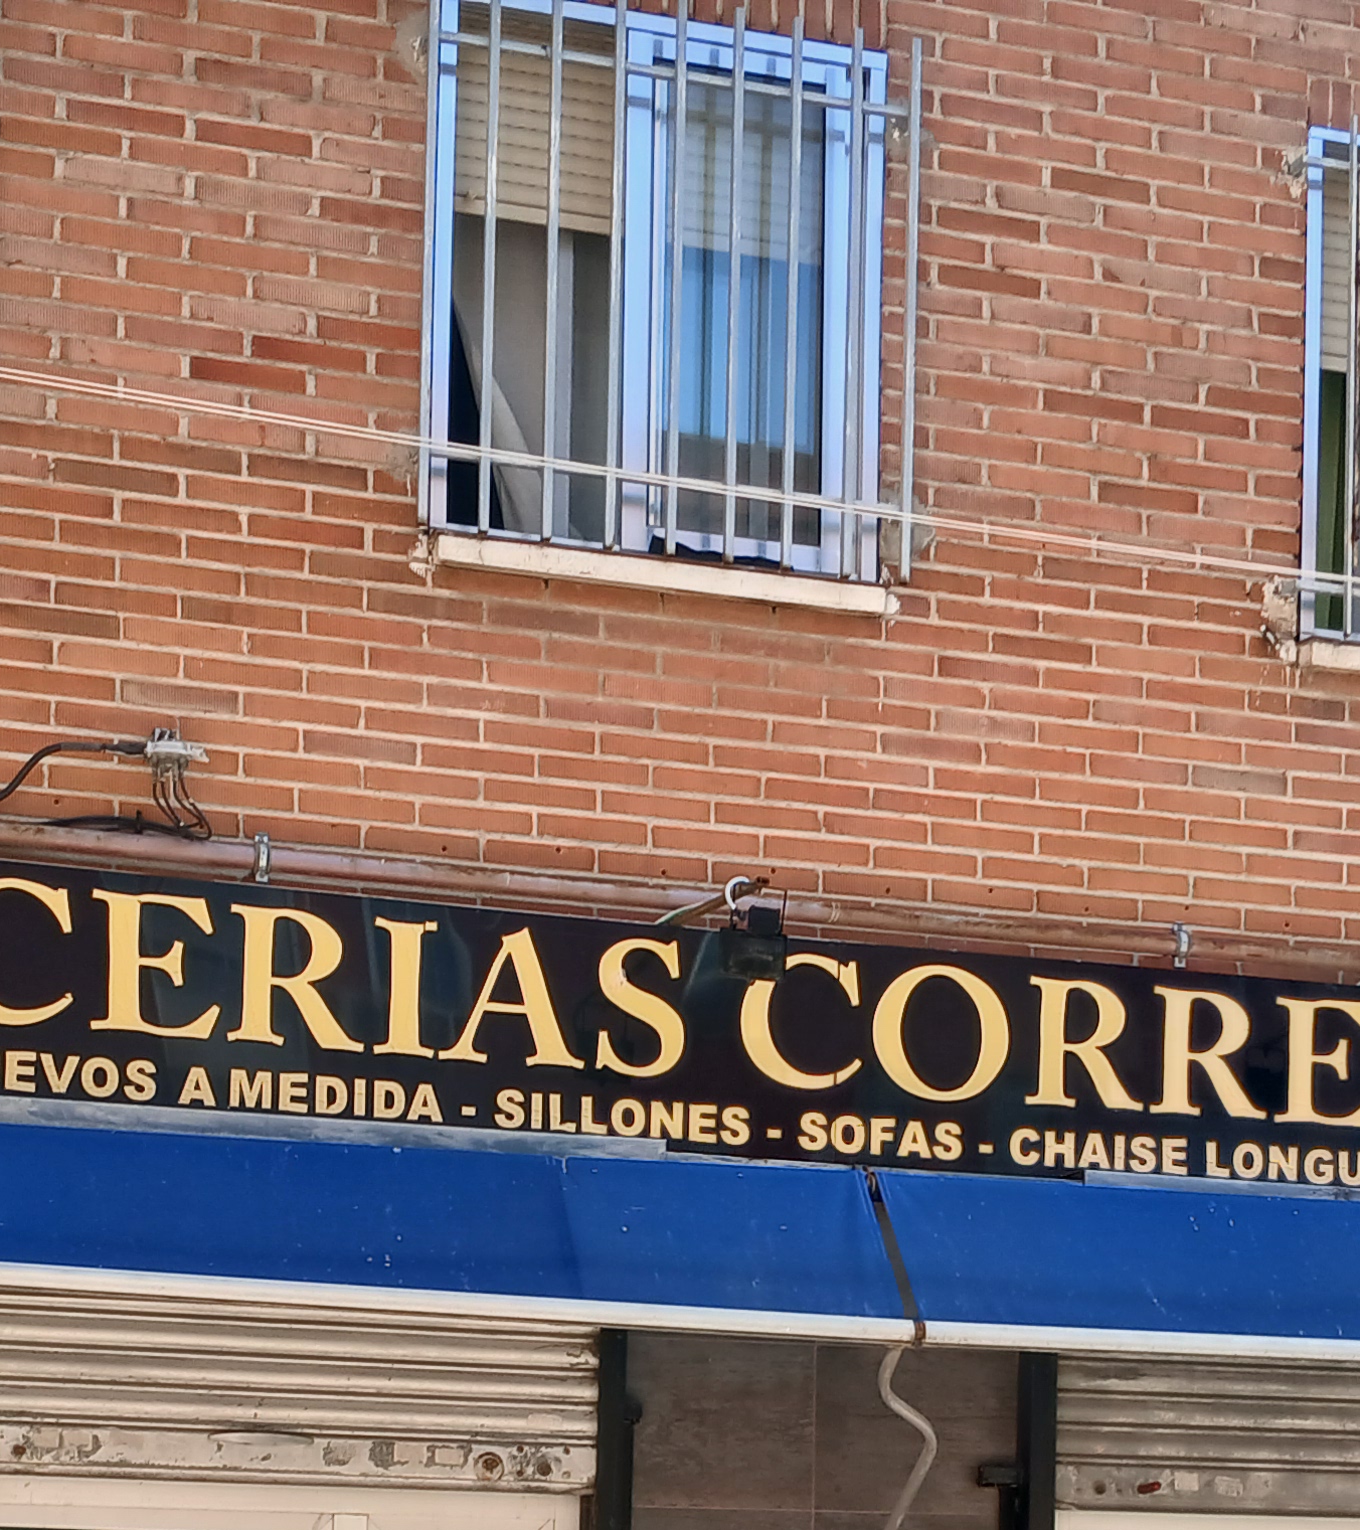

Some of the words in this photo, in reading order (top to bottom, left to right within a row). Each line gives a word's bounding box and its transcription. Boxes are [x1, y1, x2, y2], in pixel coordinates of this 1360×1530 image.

[179, 1067, 216, 1106] A
[230, 1069, 443, 1122] MEDIDA
[495, 1089, 750, 1146] SILLONES
[798, 1112, 963, 1161] SOFAS
[1010, 1128, 1188, 1175] CHAISE
